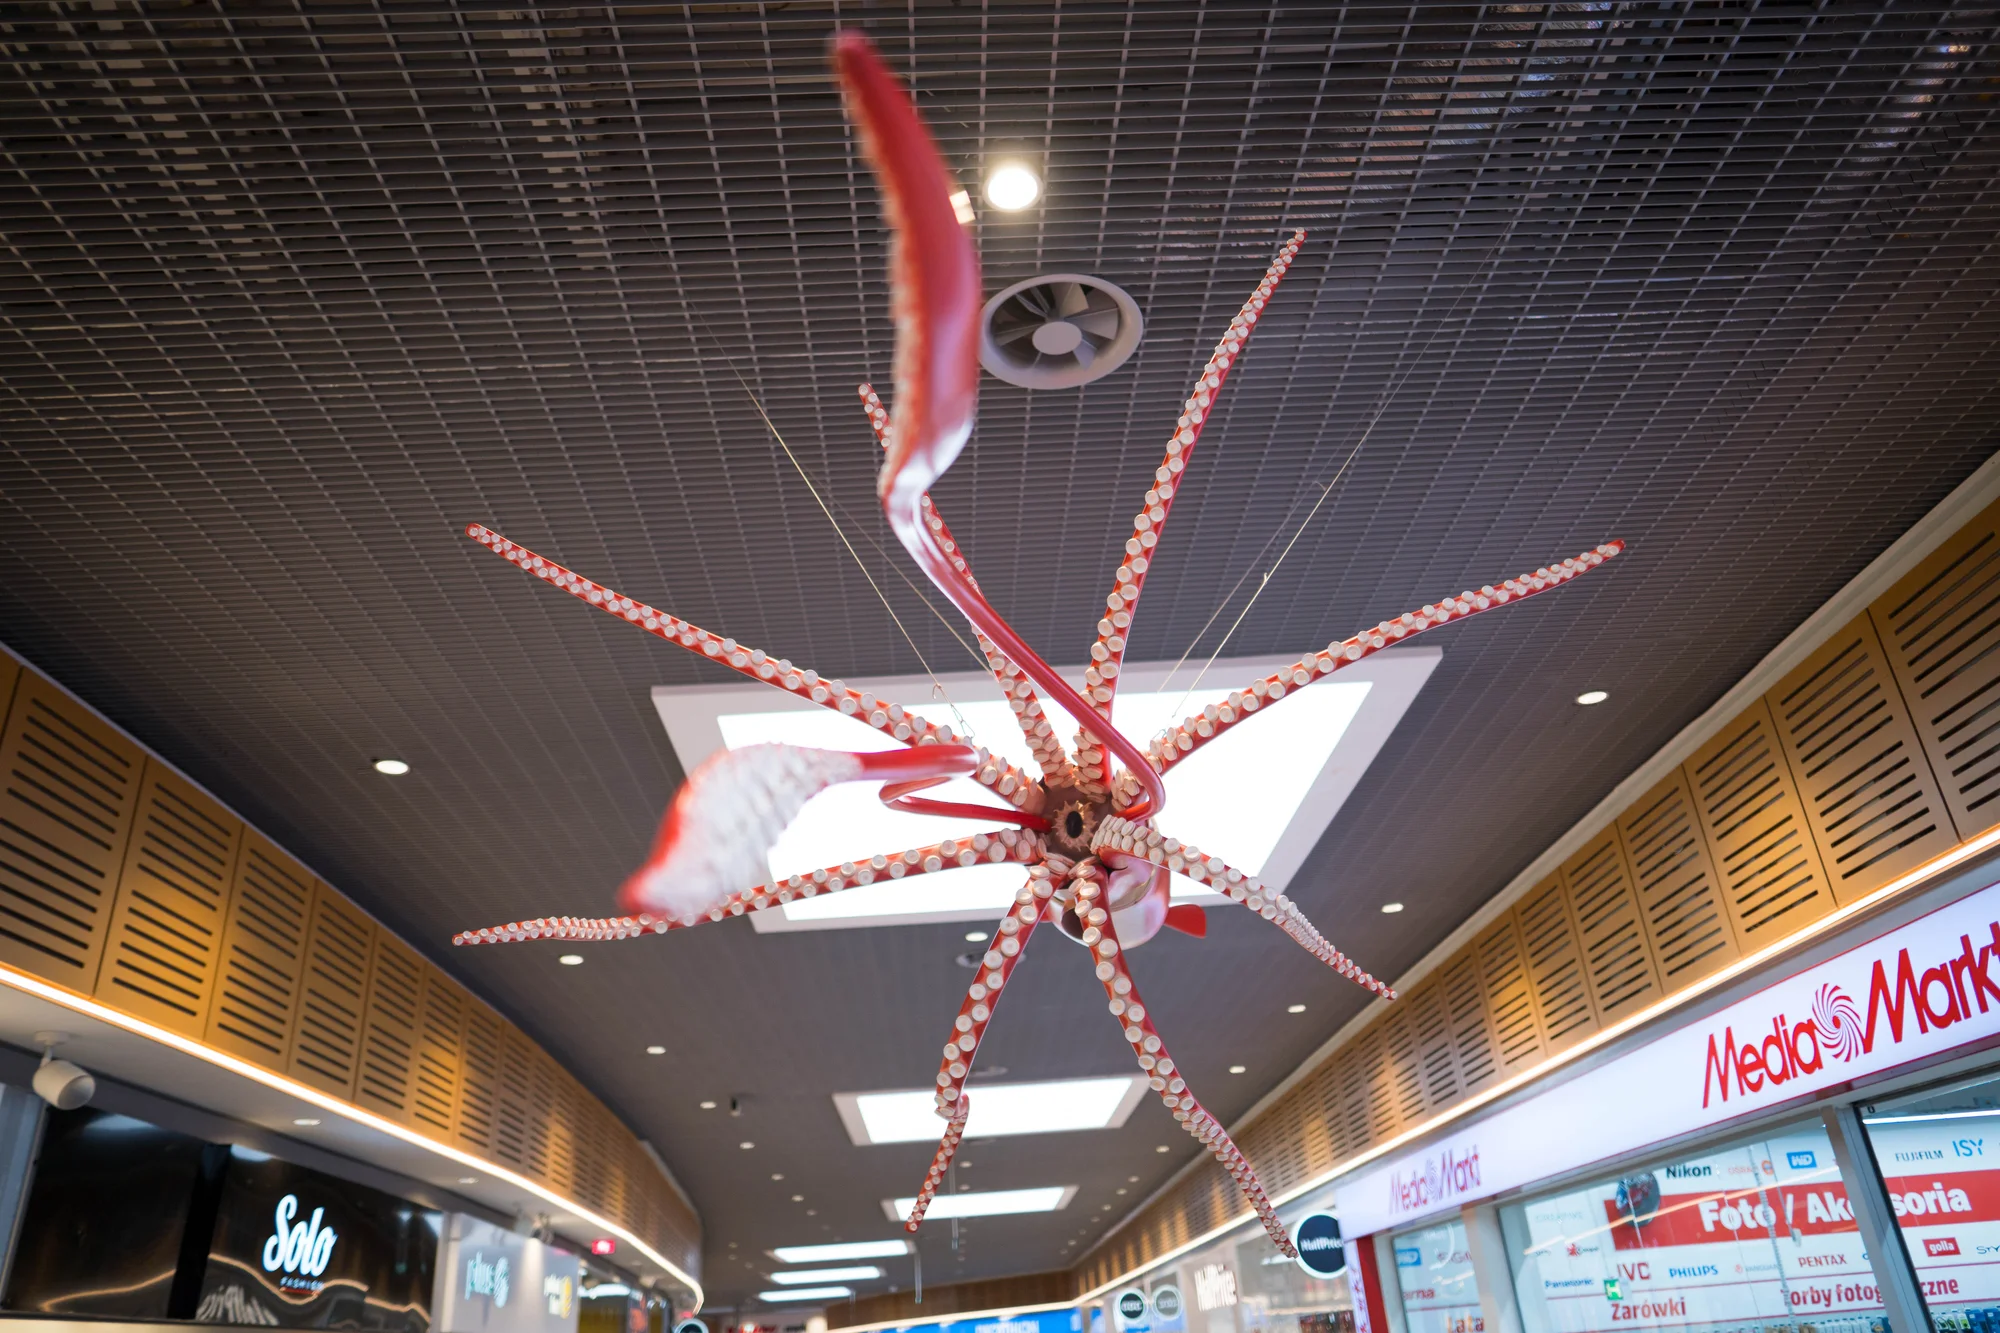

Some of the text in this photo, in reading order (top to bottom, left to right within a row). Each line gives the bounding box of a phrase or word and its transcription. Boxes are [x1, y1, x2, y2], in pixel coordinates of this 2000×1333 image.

[1702, 1013, 1823, 1109] Media
[1952, 1138, 1983, 1157] ISY
[1790, 1154, 1813, 1167] WD
[1894, 1150, 1944, 1162] FUJIFILM
[1666, 1164, 1712, 1179] Nikon
[1698, 1197, 1776, 1234] Foto
[262, 1193, 338, 1277] Solo
[1929, 1240, 1955, 1255] golla
[1798, 1254, 1848, 1268] PENTAX
[1668, 1264, 1719, 1279] PHILIPS
[1781, 1286, 1831, 1308] orby
